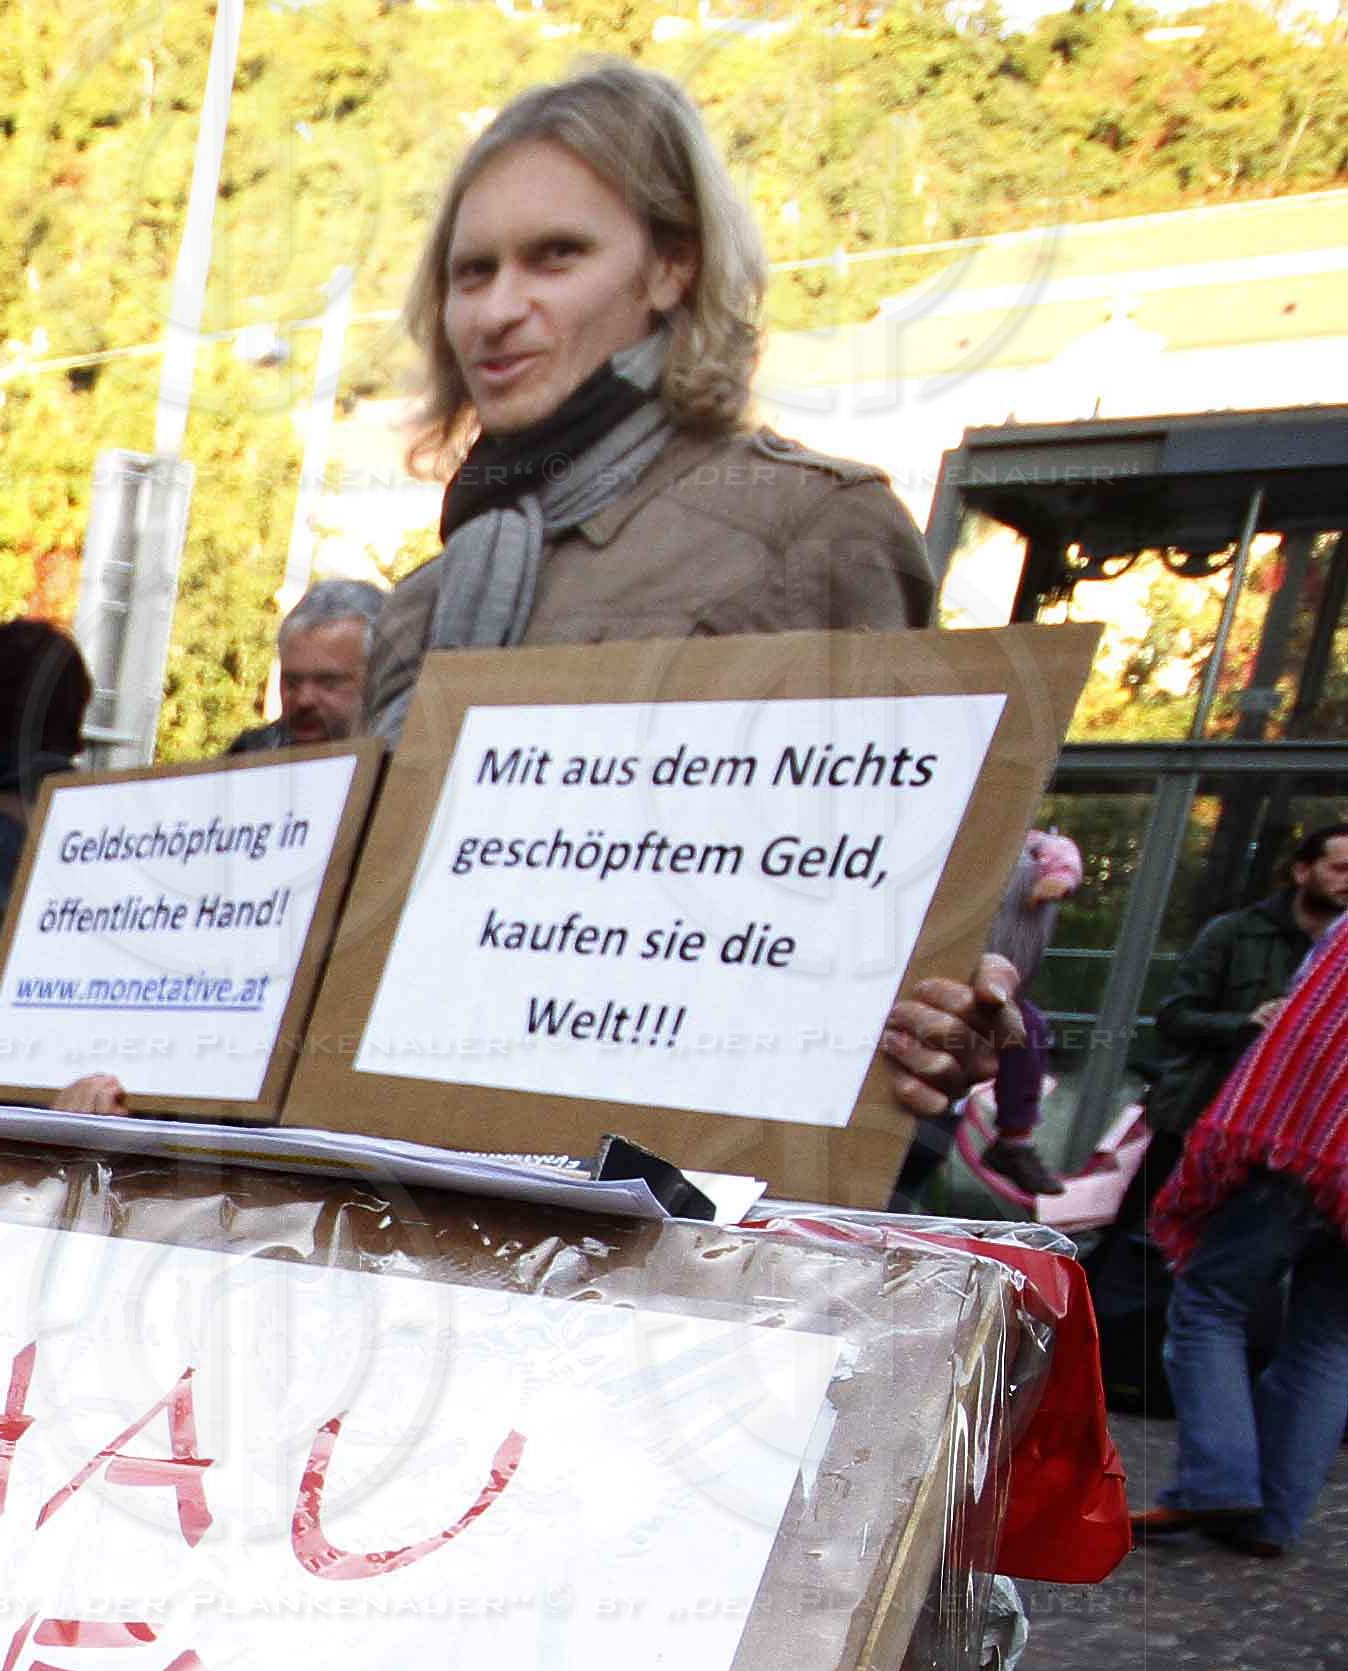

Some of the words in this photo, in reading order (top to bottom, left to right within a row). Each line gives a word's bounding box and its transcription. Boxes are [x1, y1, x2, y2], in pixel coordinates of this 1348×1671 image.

[476, 746, 548, 787] Mit
[562, 753, 638, 787] aus
[651, 744, 757, 787] dem
[771, 742, 938, 788] Nichts
[59, 816, 272, 867] Geldschöpfung
[280, 810, 310, 848] in
[451, 829, 744, 881] geschöpftem
[761, 833, 890, 889] Geld,
[39, 894, 187, 934] öffentliche
[195, 886, 292, 929] Hand!
[480, 909, 628, 958] kaufen
[641, 919, 706, 963] sie
[720, 924, 796, 969] die
[13, 972, 270, 1010] www.monetative.at
[525, 996, 688, 1049] Welt!!!
